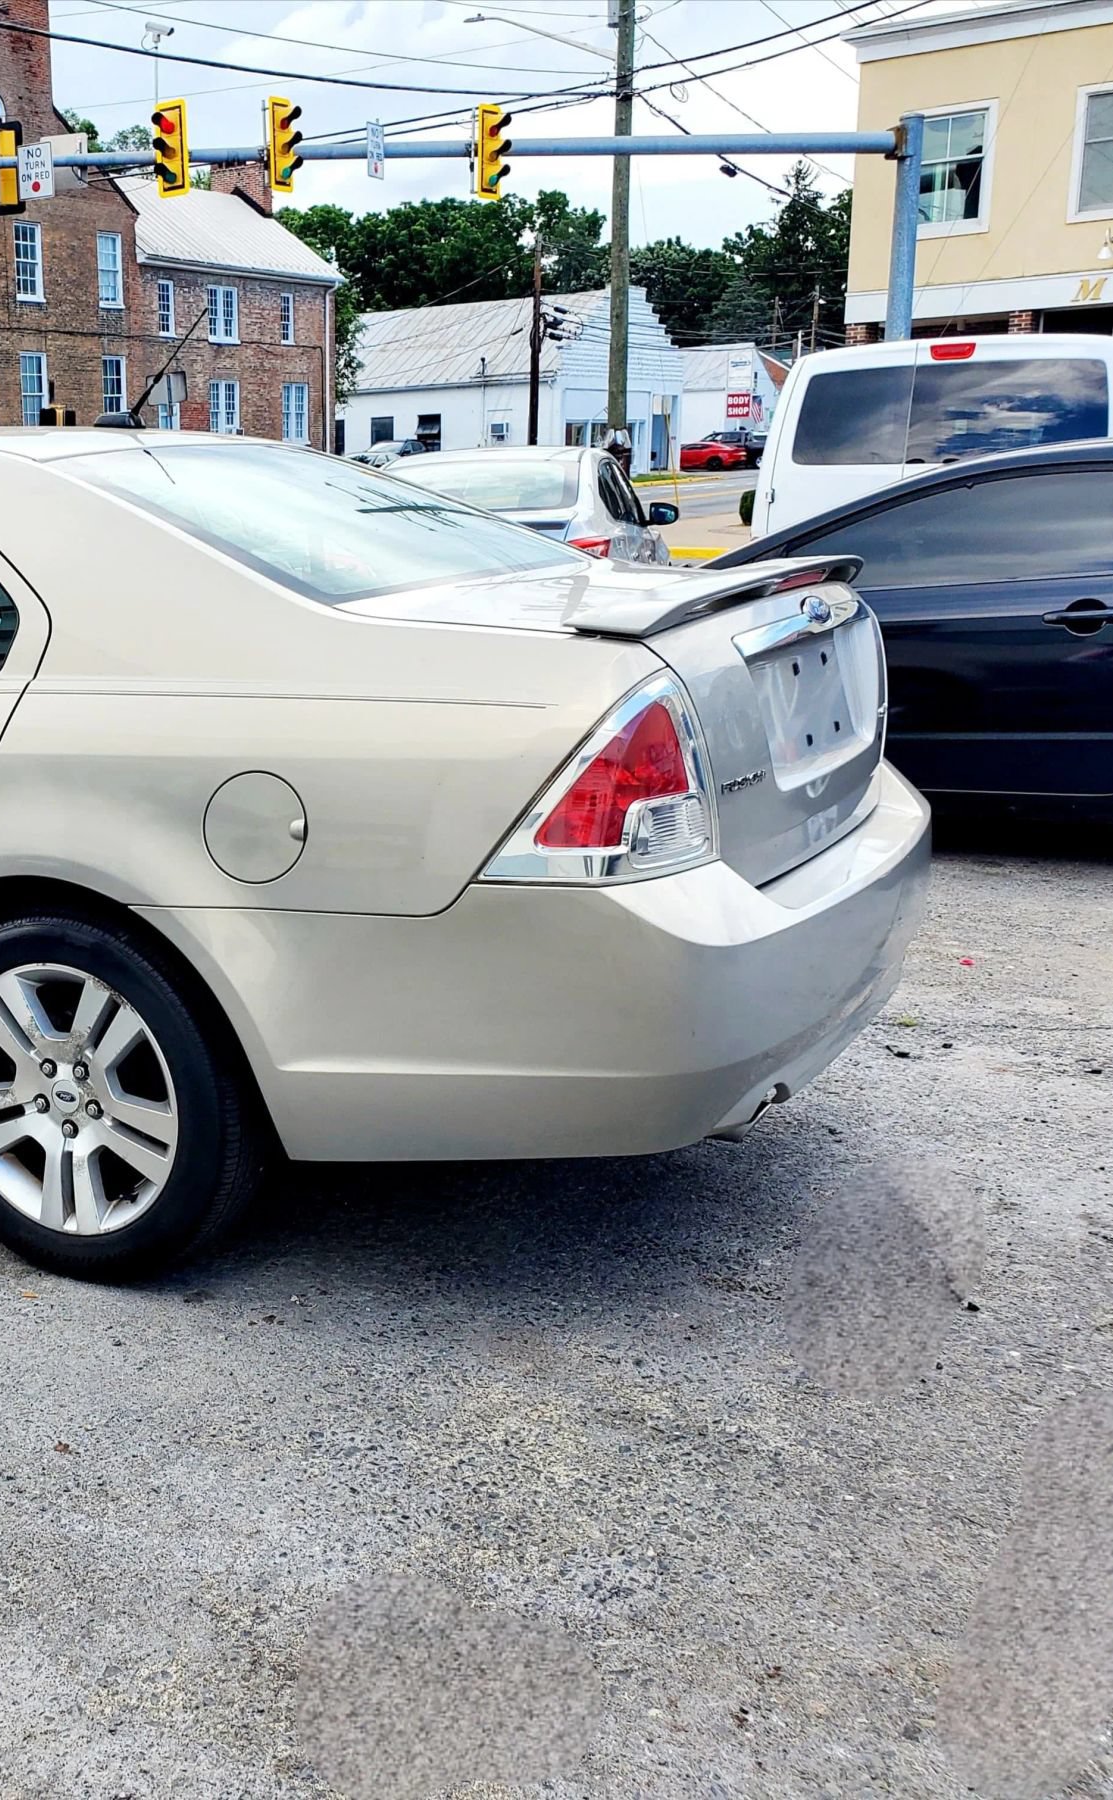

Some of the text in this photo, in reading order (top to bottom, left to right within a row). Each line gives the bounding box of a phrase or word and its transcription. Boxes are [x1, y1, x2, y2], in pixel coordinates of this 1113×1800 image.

[26, 147, 42, 158] NO
[25, 160, 46, 171] TURN
[21, 170, 50, 182] ON RED
[1070, 276, 1108, 302] M
[728, 396, 750, 405] BODY
[728, 406, 750, 416] SHOP
